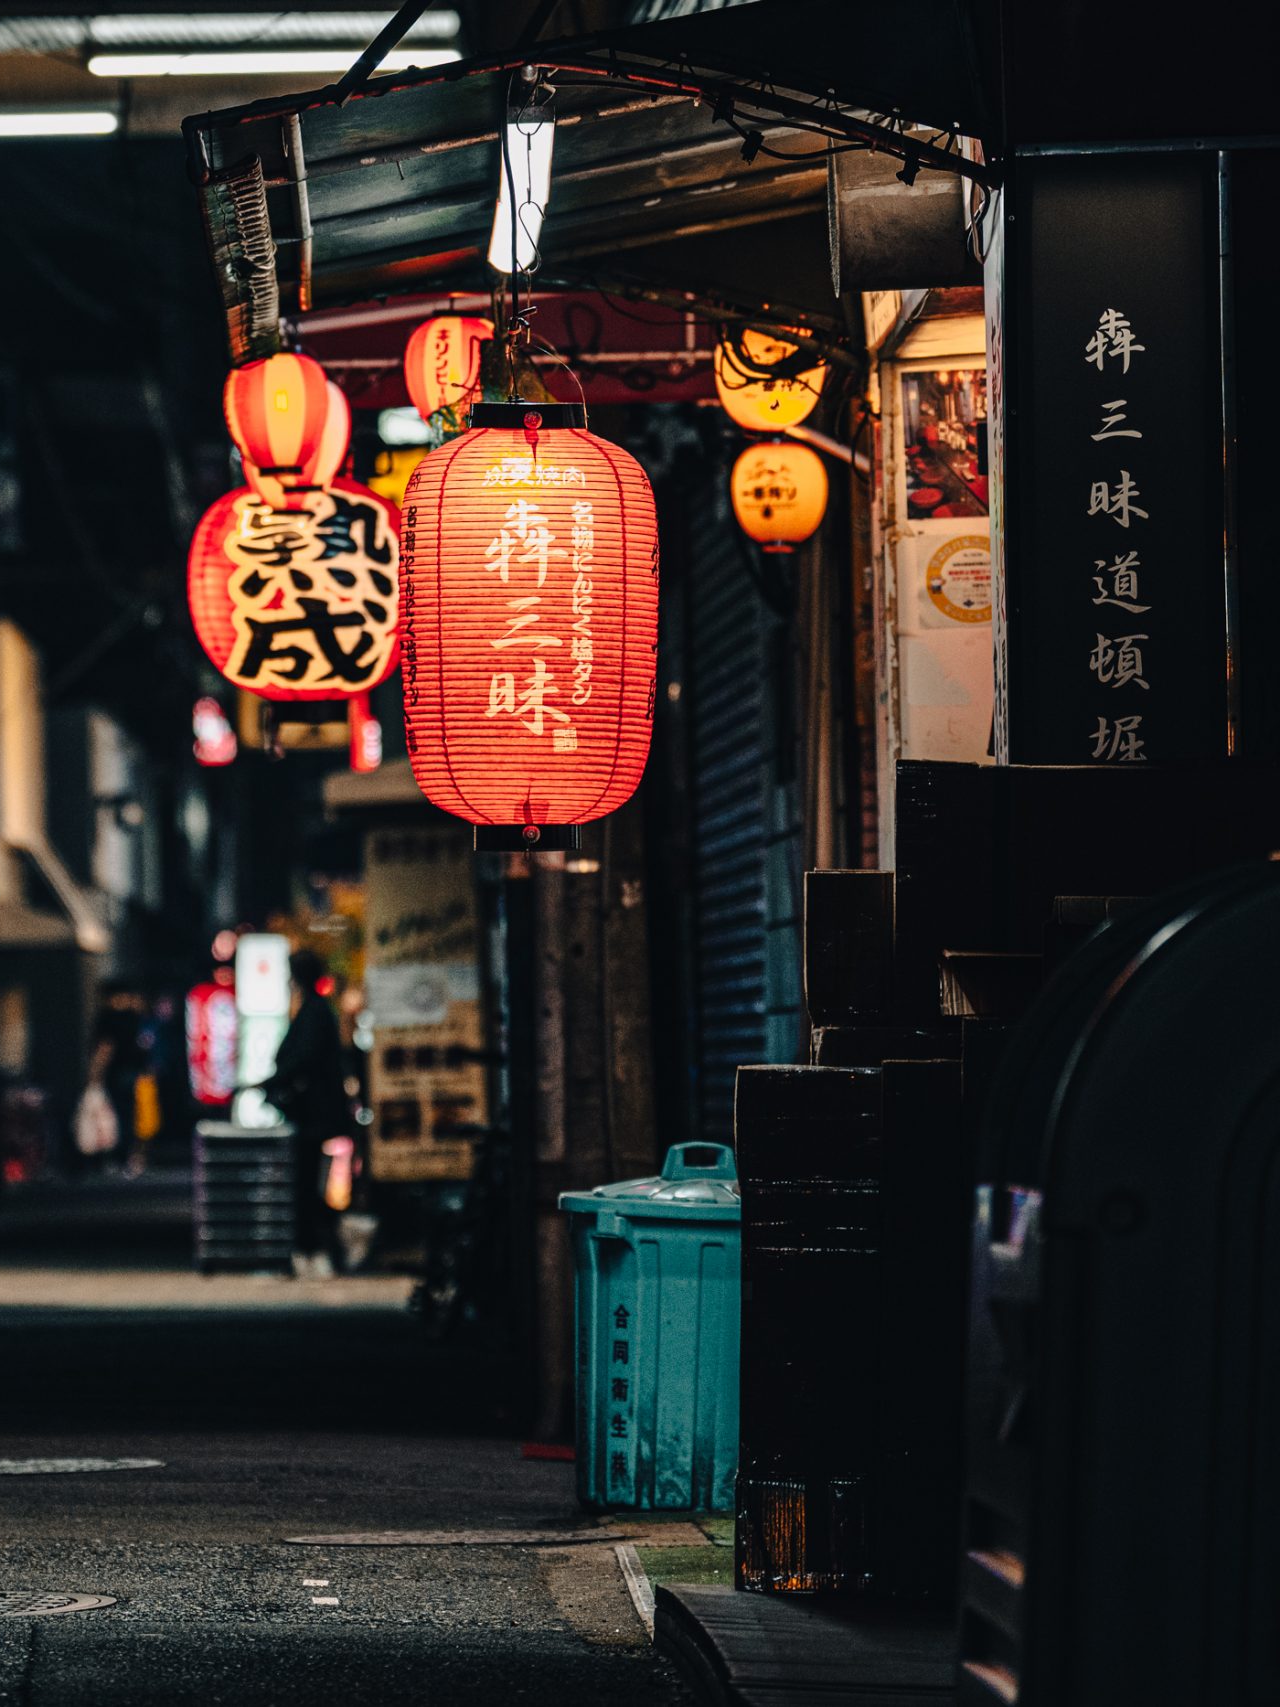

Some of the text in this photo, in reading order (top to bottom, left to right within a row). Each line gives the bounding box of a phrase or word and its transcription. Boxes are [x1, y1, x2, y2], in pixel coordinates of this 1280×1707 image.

[237, 494, 394, 682] 熟成
[484, 499, 570, 737] 犇三昧
[571, 500, 595, 706] 名物にんにく塩タン
[1084, 308, 1152, 761] 犇三昧道頓堀
